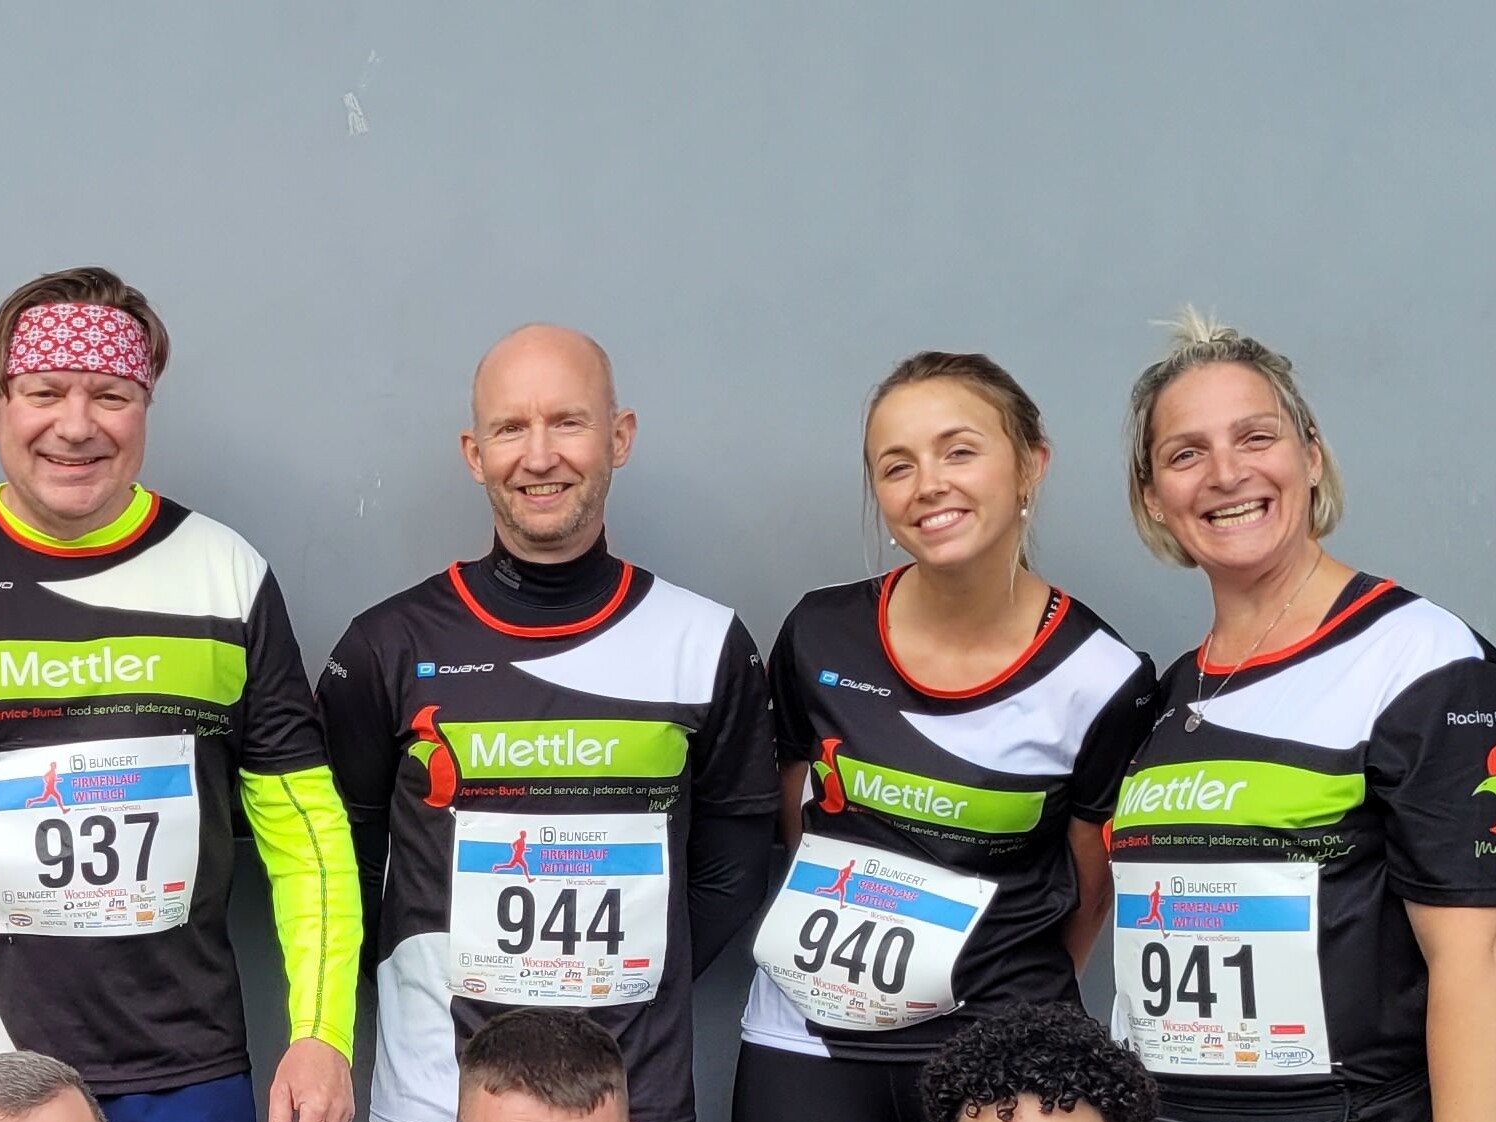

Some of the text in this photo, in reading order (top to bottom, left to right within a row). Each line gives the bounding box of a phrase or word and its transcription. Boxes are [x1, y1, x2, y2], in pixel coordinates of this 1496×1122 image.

[0, 646, 161, 688] Mettler
[66, 705, 91, 716] food
[93, 704, 133, 715] service.
[135, 703, 182, 714] jederzeit.
[184, 708, 196, 717] an
[197, 709, 219, 722] jedem
[1447, 711, 1493, 727] Racing
[471, 728, 619, 768] Mettler
[89, 756, 139, 768] BUNGERT
[73, 774, 141, 787] FIRMENLAUF
[74, 790, 125, 802] WITTLICH
[529, 786, 552, 796] food
[554, 786, 591, 795] service.
[636, 787, 647, 795] an
[853, 769, 969, 820] Mettler
[1118, 770, 1247, 817] Mettler
[560, 832, 608, 841] BUNGERT
[911, 825, 940, 837] service.
[978, 837, 989, 845] an
[1152, 836, 1171, 845] food
[1173, 835, 1206, 845] service.
[1208, 834, 1259, 847] jederzeit.
[1263, 838, 1279, 846] an
[35, 812, 160, 888] 937
[880, 866, 927, 886] BUNGERT
[1188, 882, 1238, 893] BUNGERT
[17, 891, 57, 899] BUNGERT
[109, 898, 124, 907] dm
[497, 886, 624, 955] 944
[794, 909, 914, 994] 940
[475, 955, 514, 964] BUNGERT
[565, 969, 582, 979] dm
[773, 966, 807, 980] BUNGERT
[1142, 942, 1257, 1019] 941
[849, 998, 864, 1008] dm
[1204, 1034, 1221, 1044] dm
